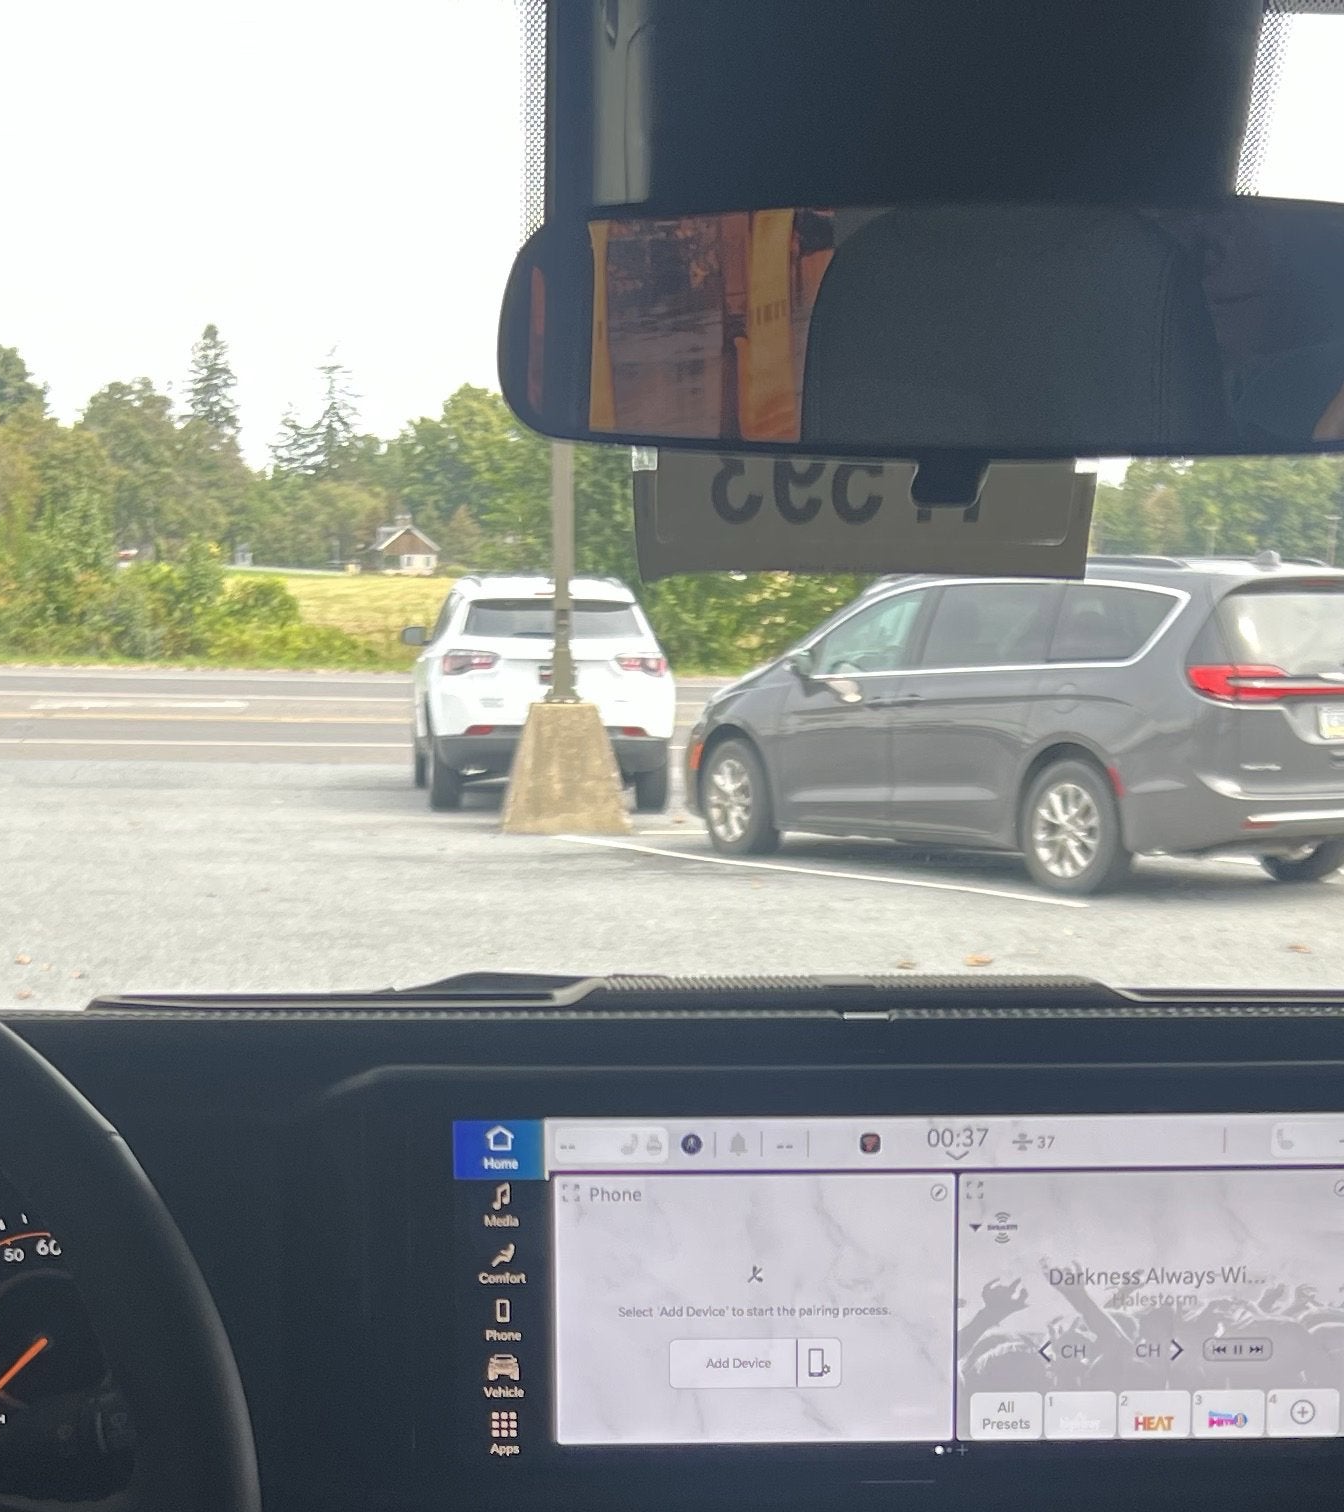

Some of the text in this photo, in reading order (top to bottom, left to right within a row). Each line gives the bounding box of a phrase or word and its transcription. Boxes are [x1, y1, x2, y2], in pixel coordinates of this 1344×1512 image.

[927, 1127, 989, 1148] 00:37
[1037, 1135, 1056, 1149] 37
[483, 1157, 519, 1170] Home
[589, 1187, 642, 1203] Phone
[484, 1215, 520, 1228] Media
[35, 1238, 62, 1256] 60
[4, 1247, 25, 1262] 50
[479, 1272, 527, 1285] Comfort
[1049, 1265, 1266, 1289] Darkness Always Wi...
[1112, 1292, 1198, 1307] Halestorm
[618, 1306, 654, 1318] Select
[732, 1305, 744, 1317] to
[746, 1305, 775, 1317] start
[777, 1305, 797, 1317] the
[799, 1304, 840, 1319] pairing
[842, 1305, 892, 1319] process.
[485, 1329, 522, 1342] Phone
[1061, 1344, 1086, 1359] CH
[1135, 1343, 1161, 1359] CH
[706, 1357, 772, 1370] Add Device
[483, 1386, 525, 1399] Vehicle
[1268, 1393, 1278, 1405] 4
[1120, 1395, 1129, 1407] 2
[1194, 1395, 1203, 1405] 3
[997, 1401, 1015, 1414] All
[981, 1417, 1031, 1431] Presets
[1134, 1416, 1174, 1432] HEAT
[489, 1443, 521, 1457] Apps
